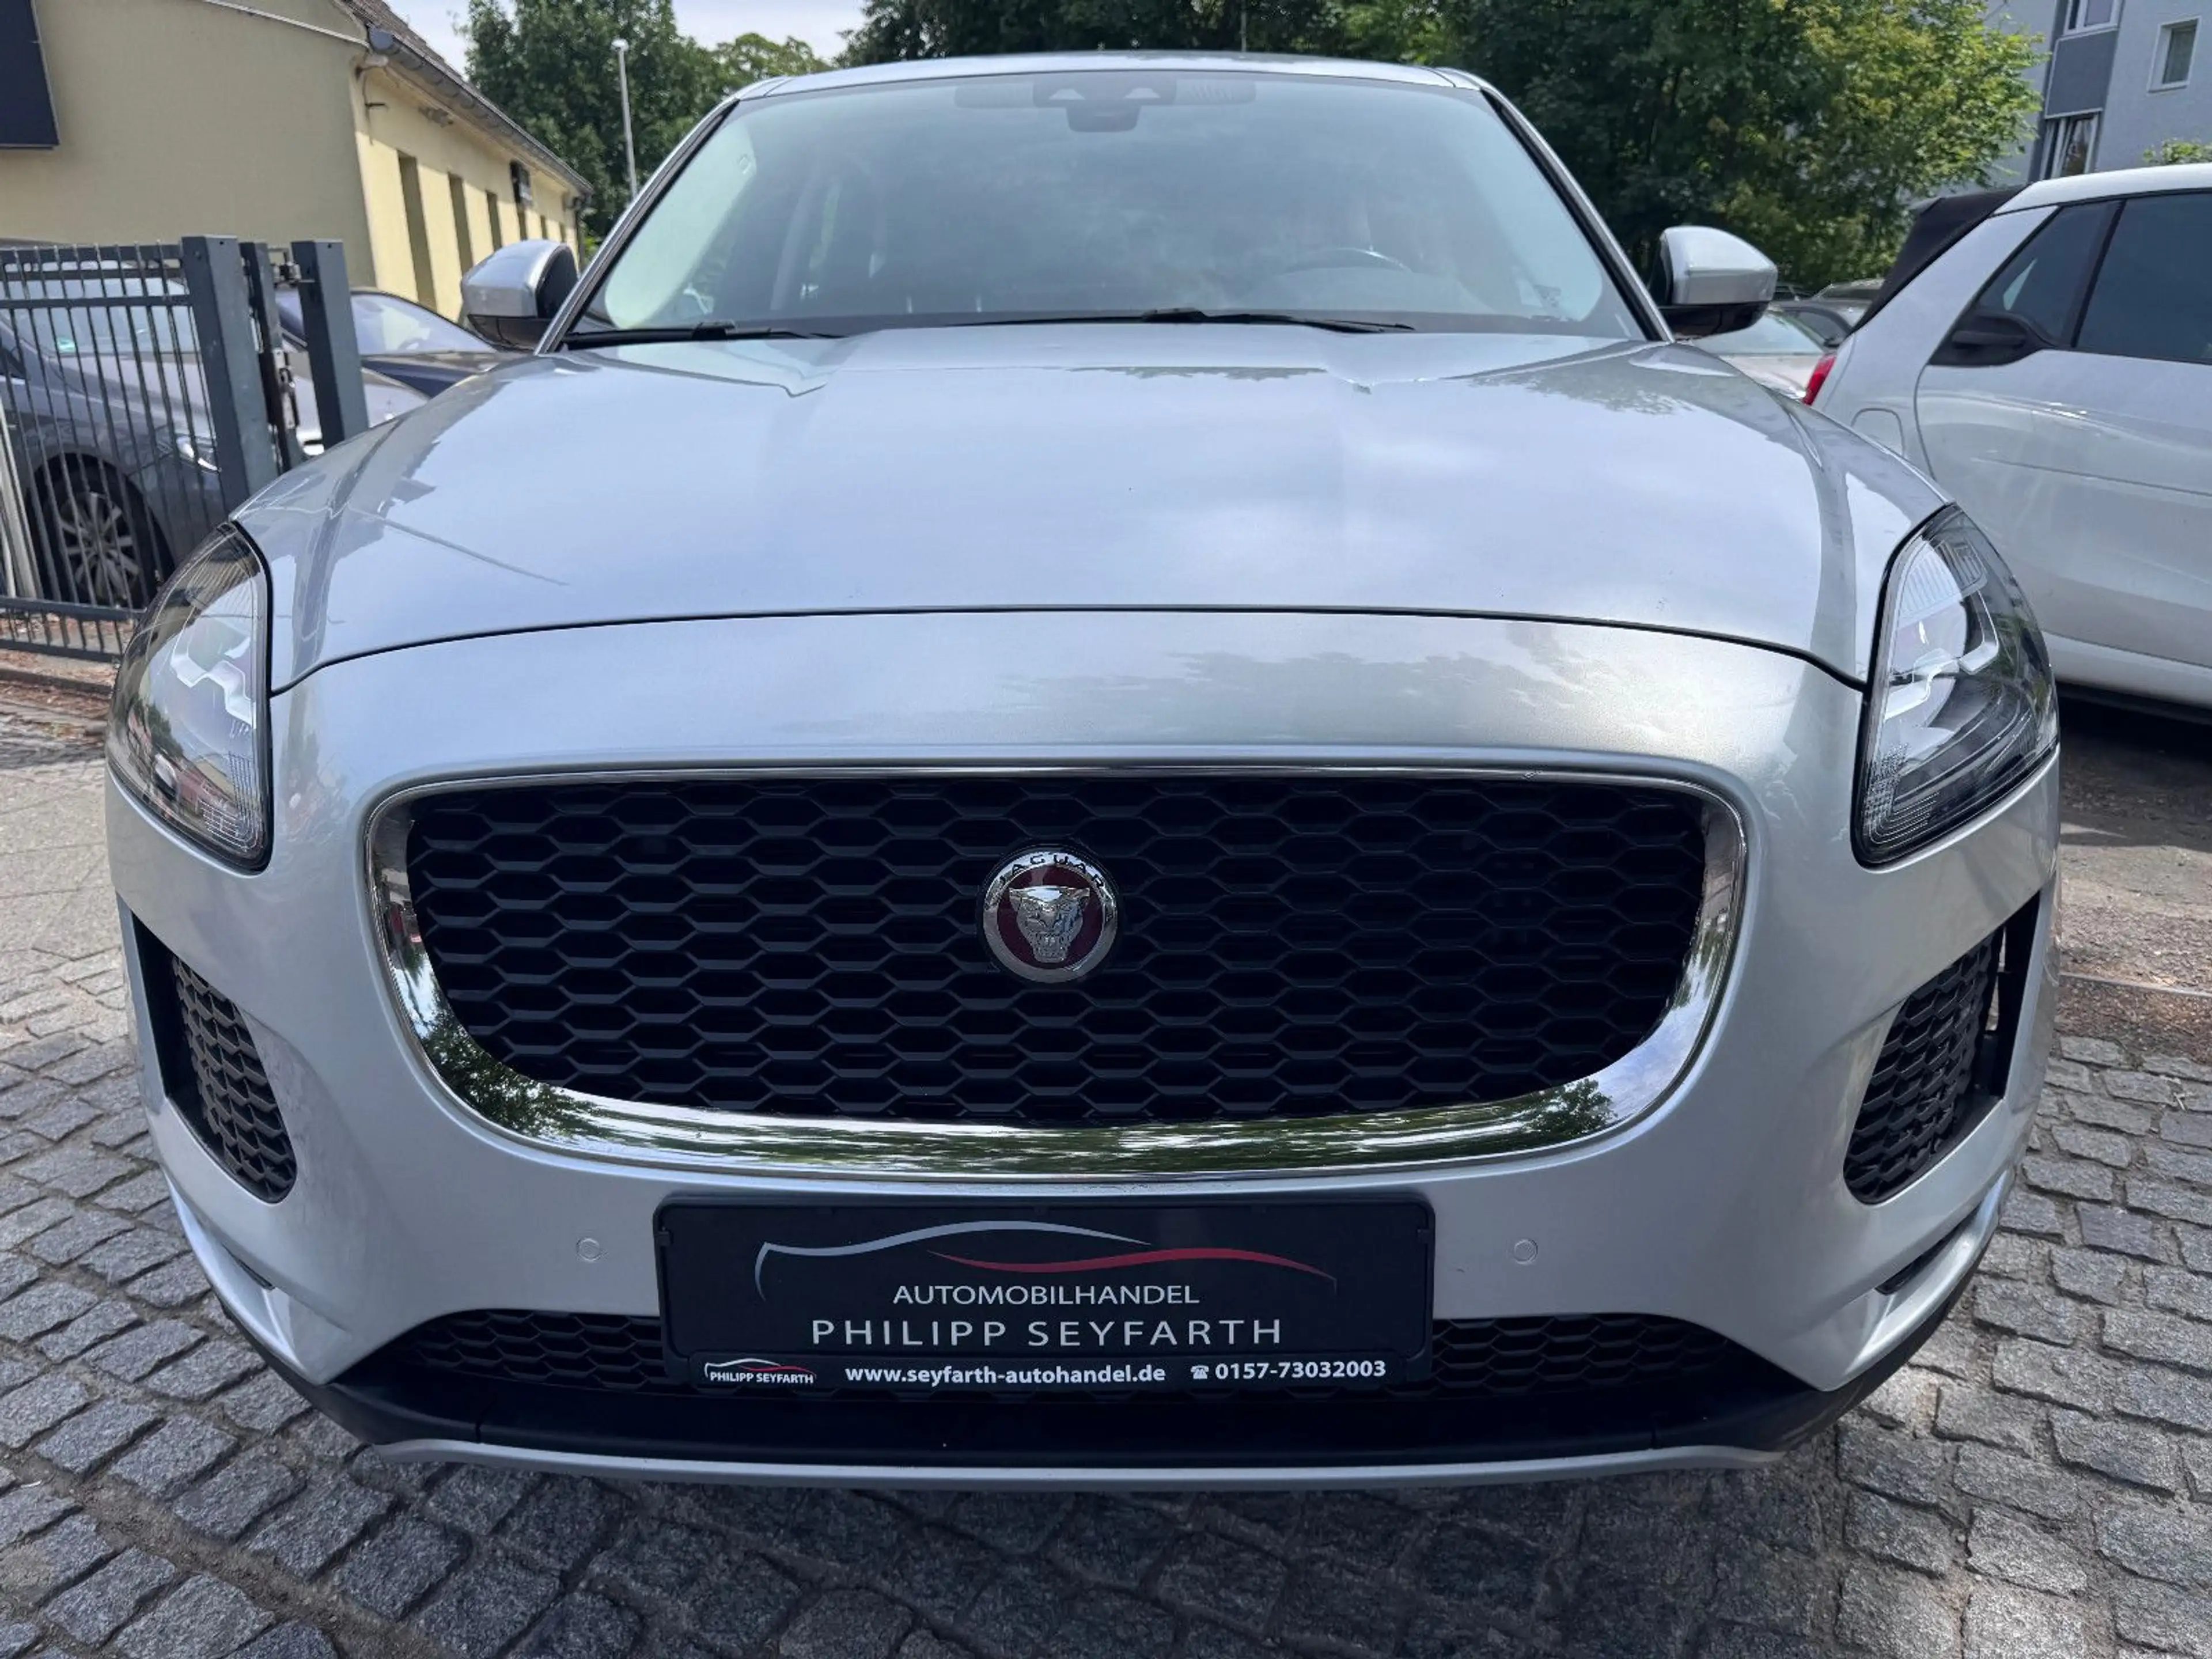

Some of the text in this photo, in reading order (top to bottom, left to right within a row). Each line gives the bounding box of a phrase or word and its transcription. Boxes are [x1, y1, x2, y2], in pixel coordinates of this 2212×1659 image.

[893, 1285, 1200, 1305] AUTOMOBILHANDEL
[813, 1319, 1281, 1347] PHILIPP SEYFARTH
[710, 1371, 814, 1384] PHILIPP SEYFARTH
[844, 1363, 1166, 1387] www.seyfarth-autohandel.de
[1214, 1360, 1387, 1380] 0157-73032003
